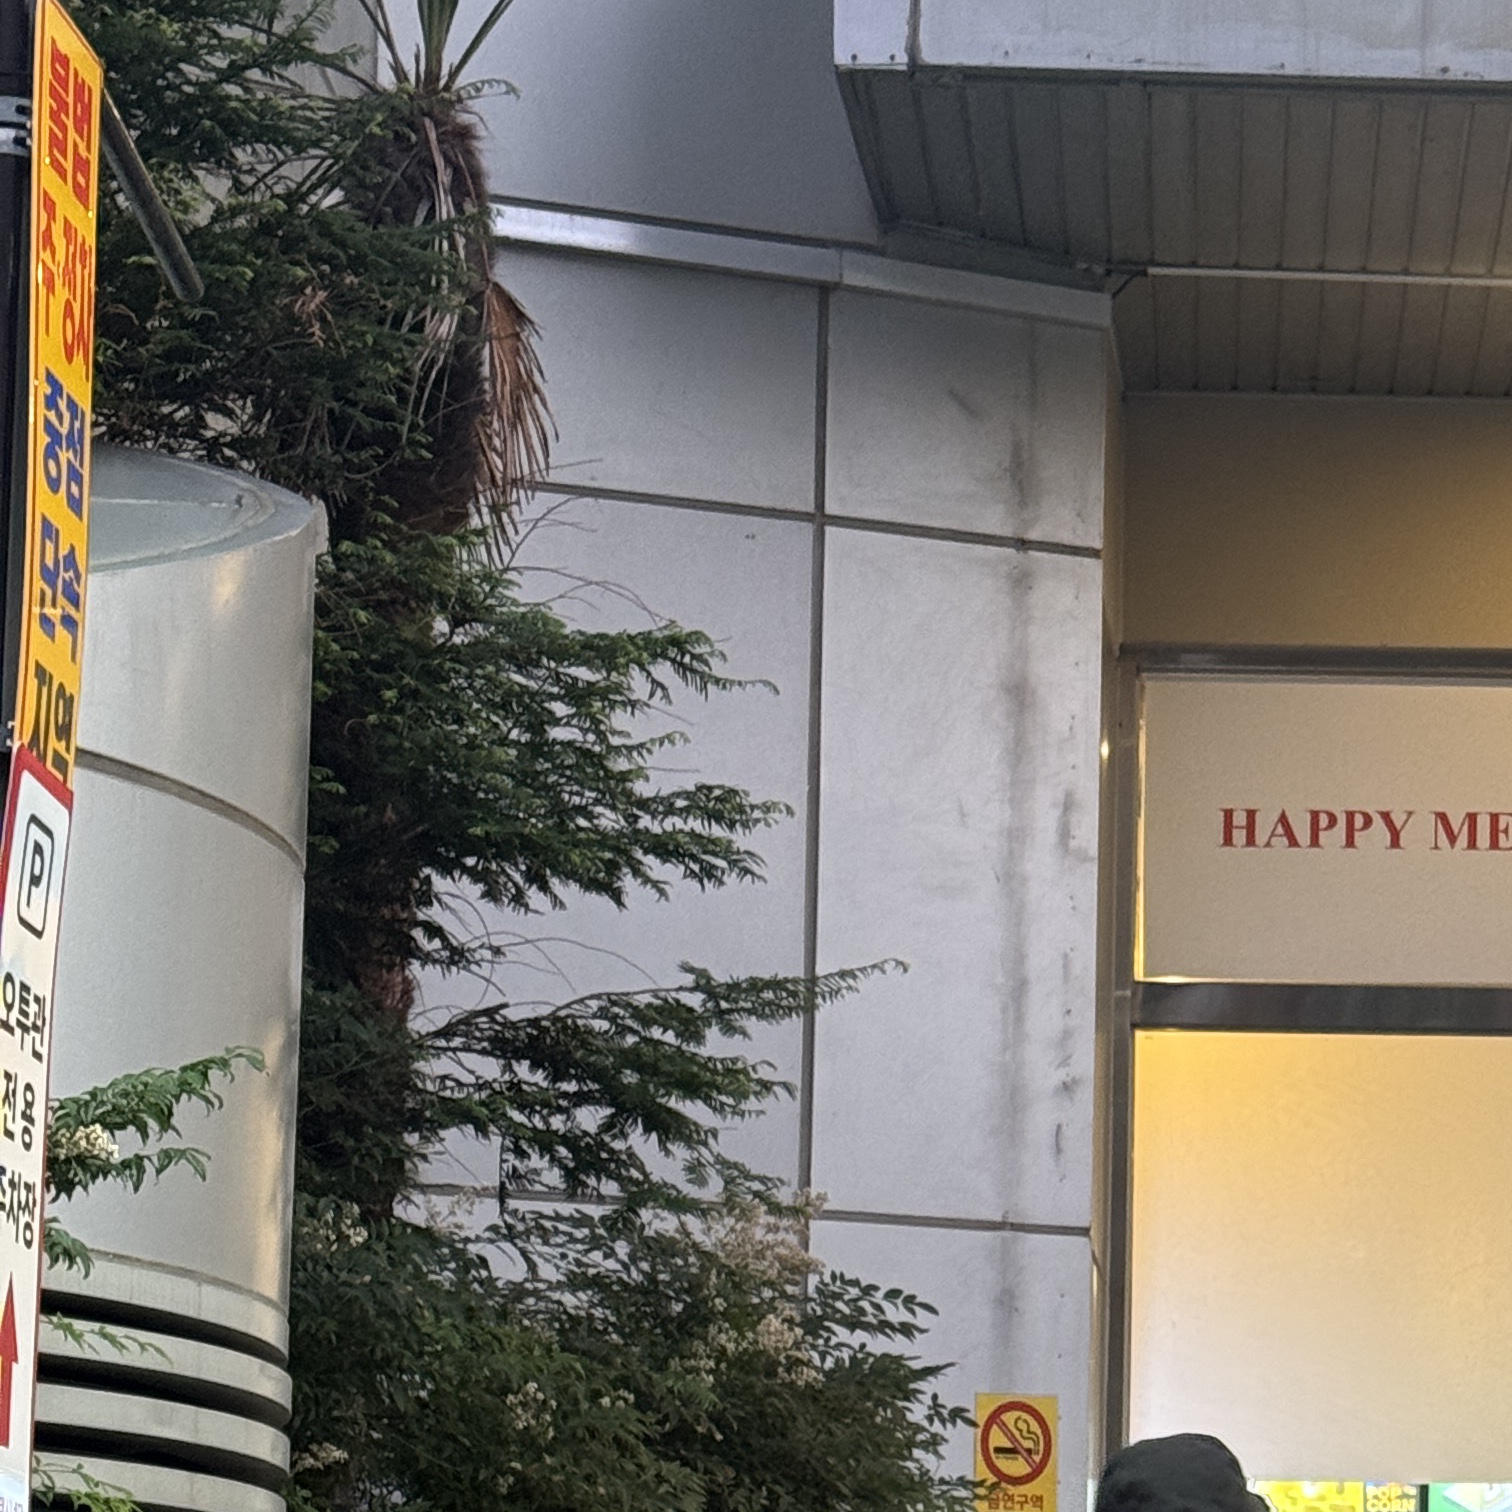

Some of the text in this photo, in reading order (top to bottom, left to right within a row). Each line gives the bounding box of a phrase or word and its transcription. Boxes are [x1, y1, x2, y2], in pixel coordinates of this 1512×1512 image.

[47, 33, 93, 211] 불법
[42, 365, 85, 521] 중점
[38, 511, 83, 664] 단속
[28, 658, 75, 786] 지역
[1217, 807, 1414, 851] HAPPY
[0, 970, 47, 1063] 오투관
[1366, 1498, 1416, 1512] CORN
